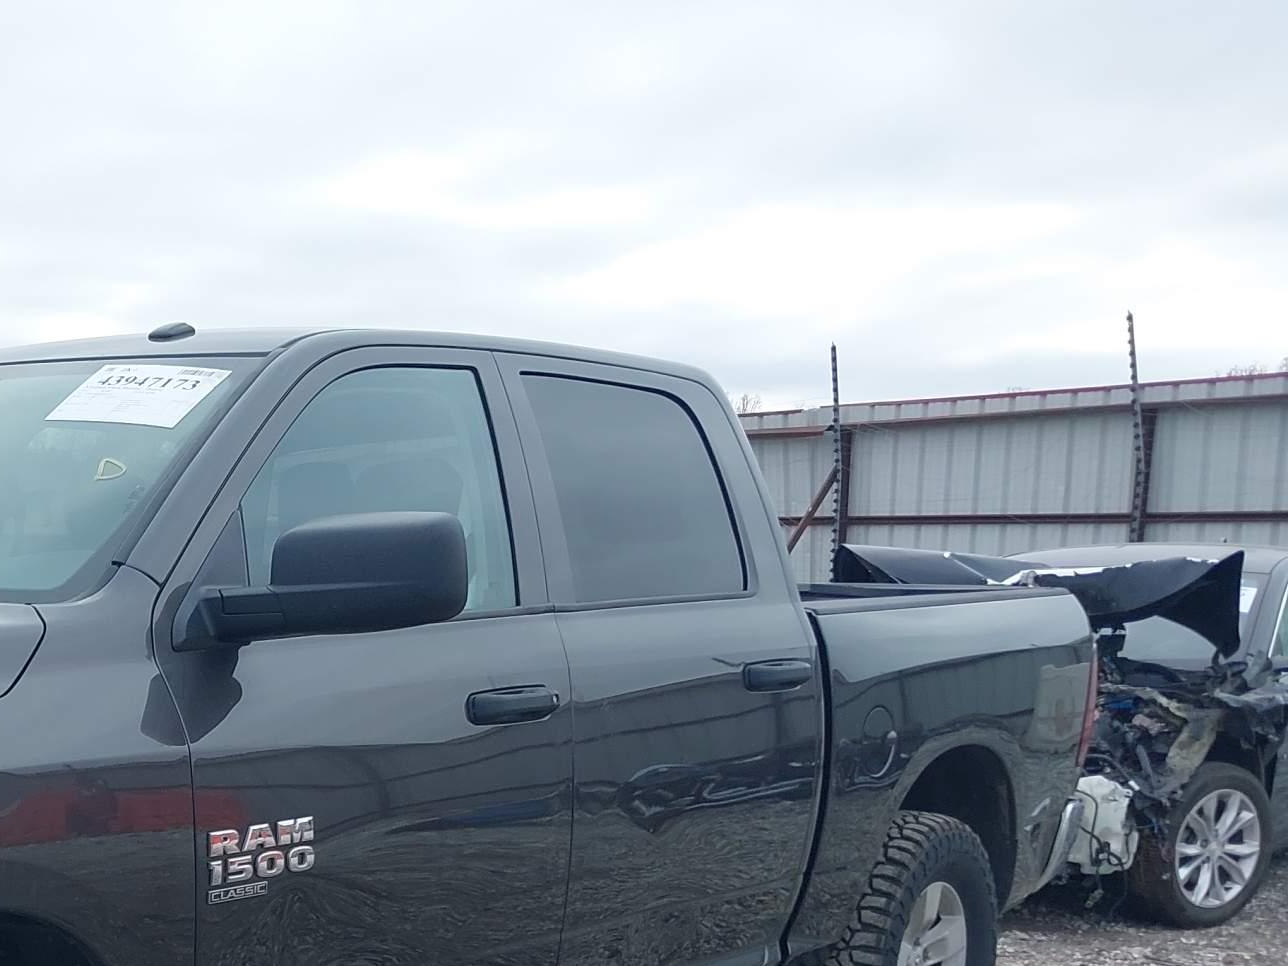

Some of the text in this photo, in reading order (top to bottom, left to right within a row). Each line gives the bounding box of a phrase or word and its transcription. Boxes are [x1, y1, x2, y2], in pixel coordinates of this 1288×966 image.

[97, 375, 201, 391] 43947173
[208, 816, 314, 858] RAM
[209, 846, 315, 887] 1500
[211, 883, 266, 902] CLASSIC
